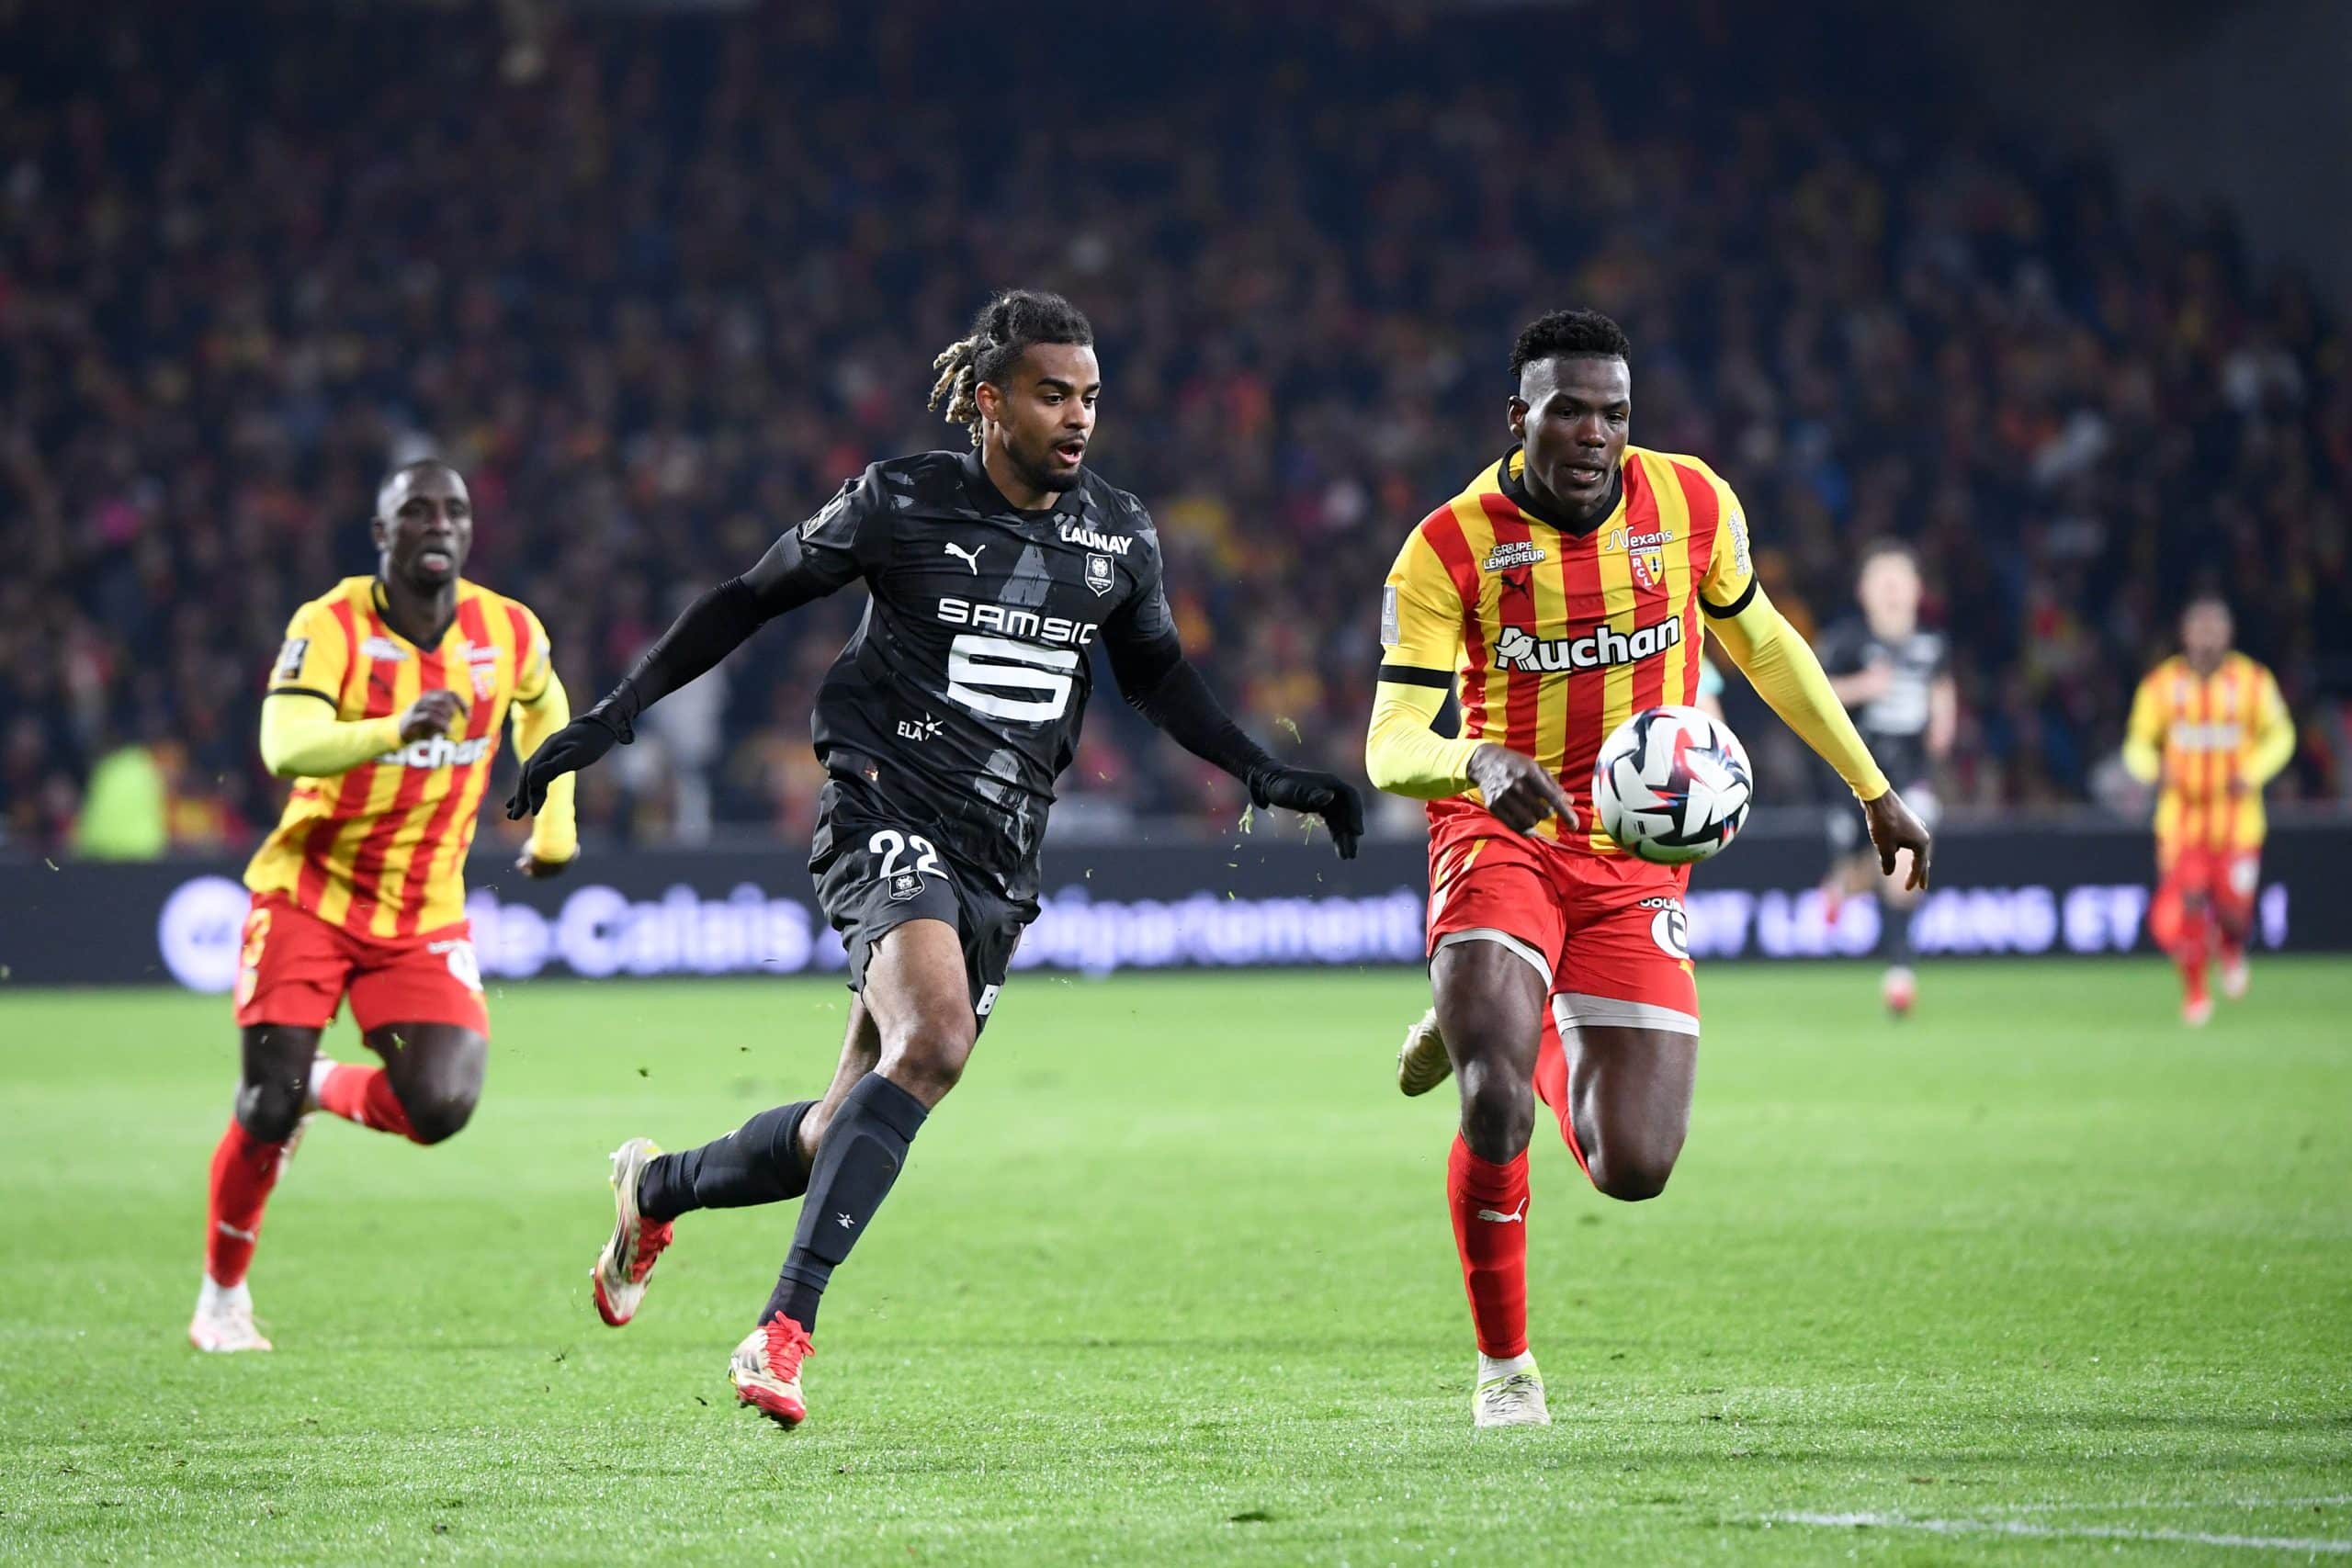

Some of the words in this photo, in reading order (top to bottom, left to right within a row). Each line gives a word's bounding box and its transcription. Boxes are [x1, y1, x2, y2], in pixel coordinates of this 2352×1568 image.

[1060, 525, 1133, 556] LAUNAY
[1492, 541, 1533, 557] GROUPE
[1605, 525, 1673, 551] Nexans
[1483, 549, 1545, 570] LEMPEREUR
[937, 597, 1098, 645] SAMSIC
[1494, 615, 1680, 672] Auchan
[897, 720, 922, 742] ELA
[868, 829, 950, 879] 22
